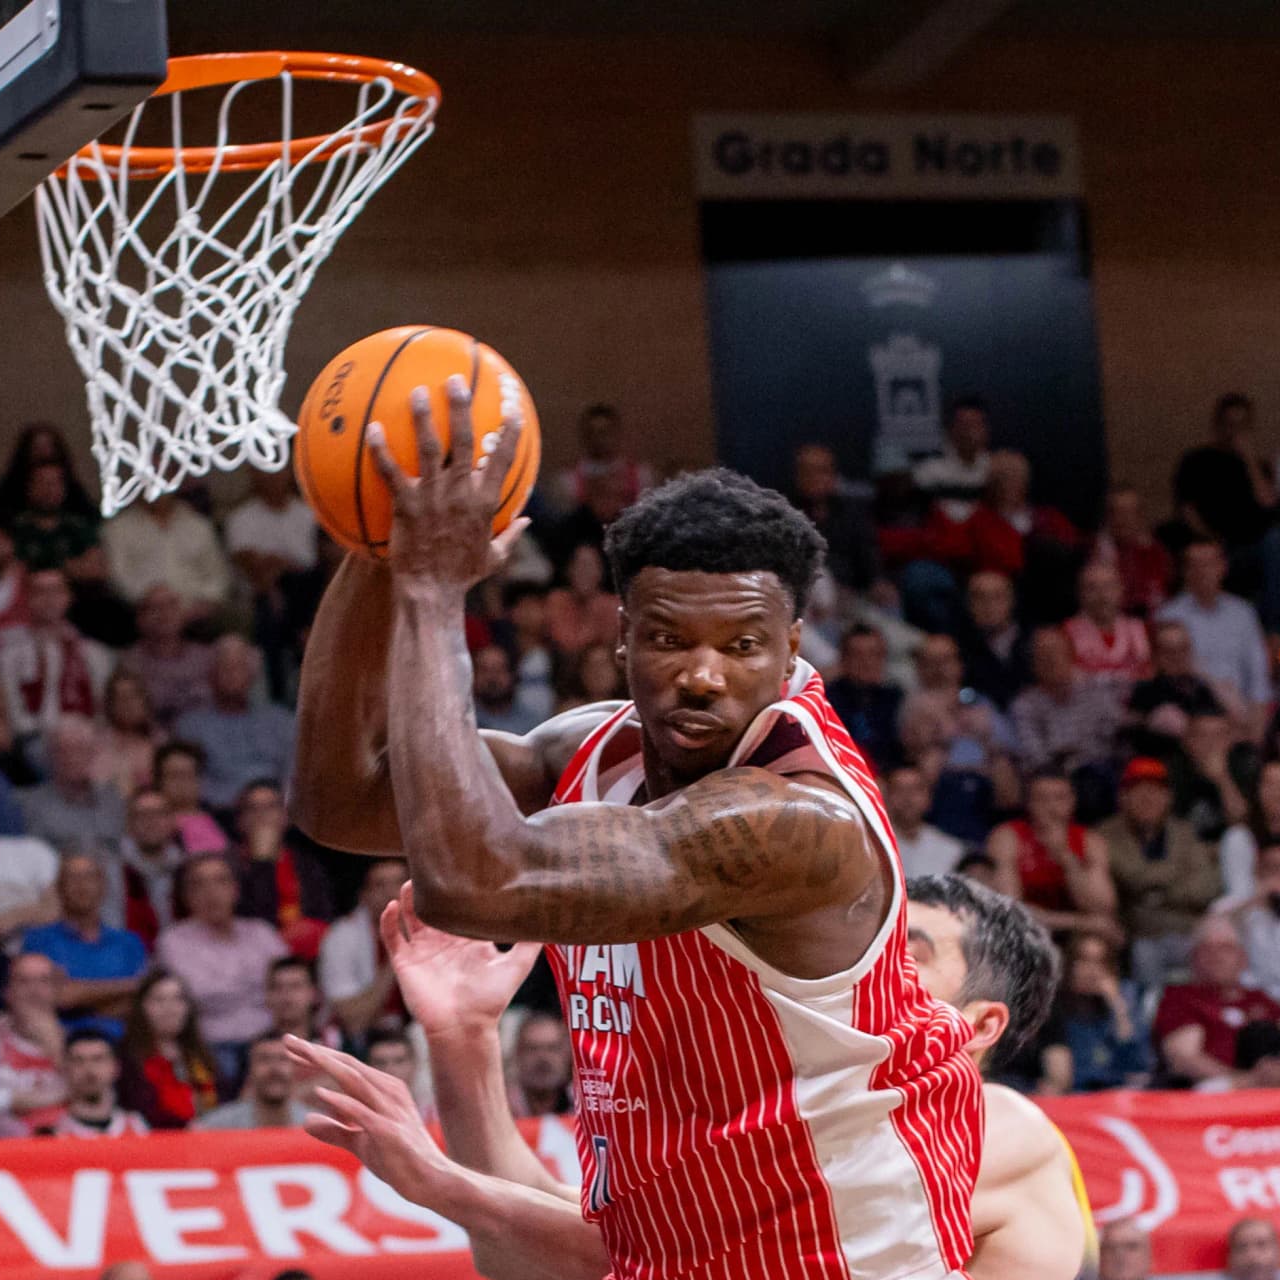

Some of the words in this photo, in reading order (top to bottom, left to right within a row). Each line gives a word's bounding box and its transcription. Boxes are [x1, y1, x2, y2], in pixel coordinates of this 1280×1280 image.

[714, 131, 889, 177] Grada
[914, 132, 1062, 178] Norte
[569, 993, 632, 1035] RCIA
